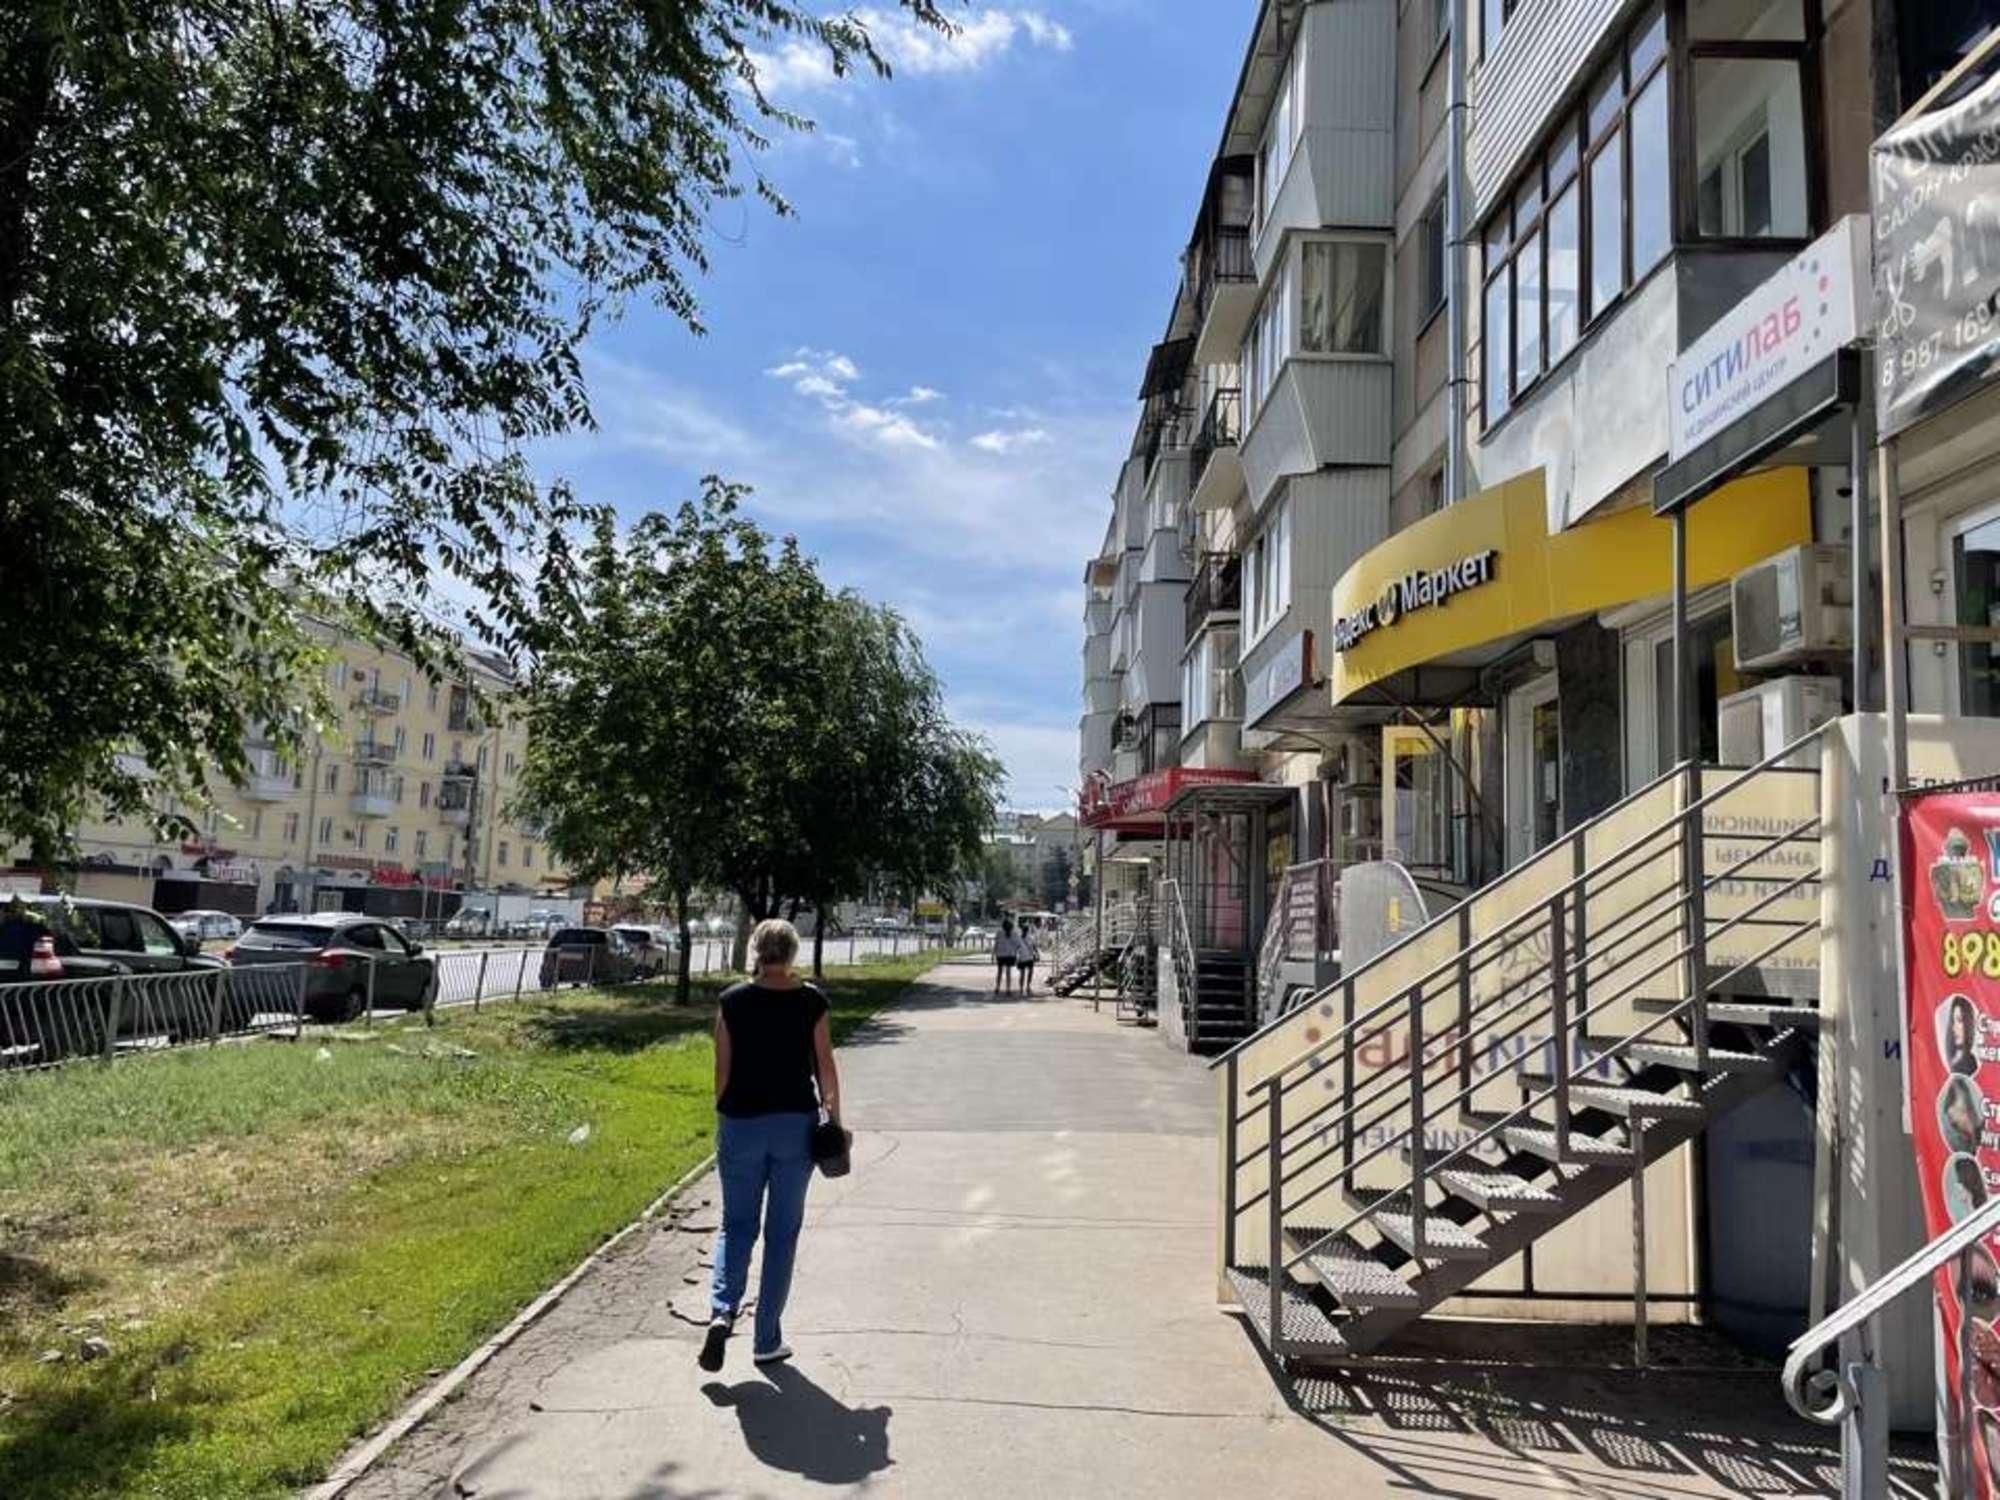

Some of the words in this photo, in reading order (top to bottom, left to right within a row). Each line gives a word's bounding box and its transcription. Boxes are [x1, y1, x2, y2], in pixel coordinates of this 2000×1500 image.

[1883, 359, 1893, 387] 8
[1901, 331, 1943, 377] 987
[1401, 550, 1493, 610] Маркет
